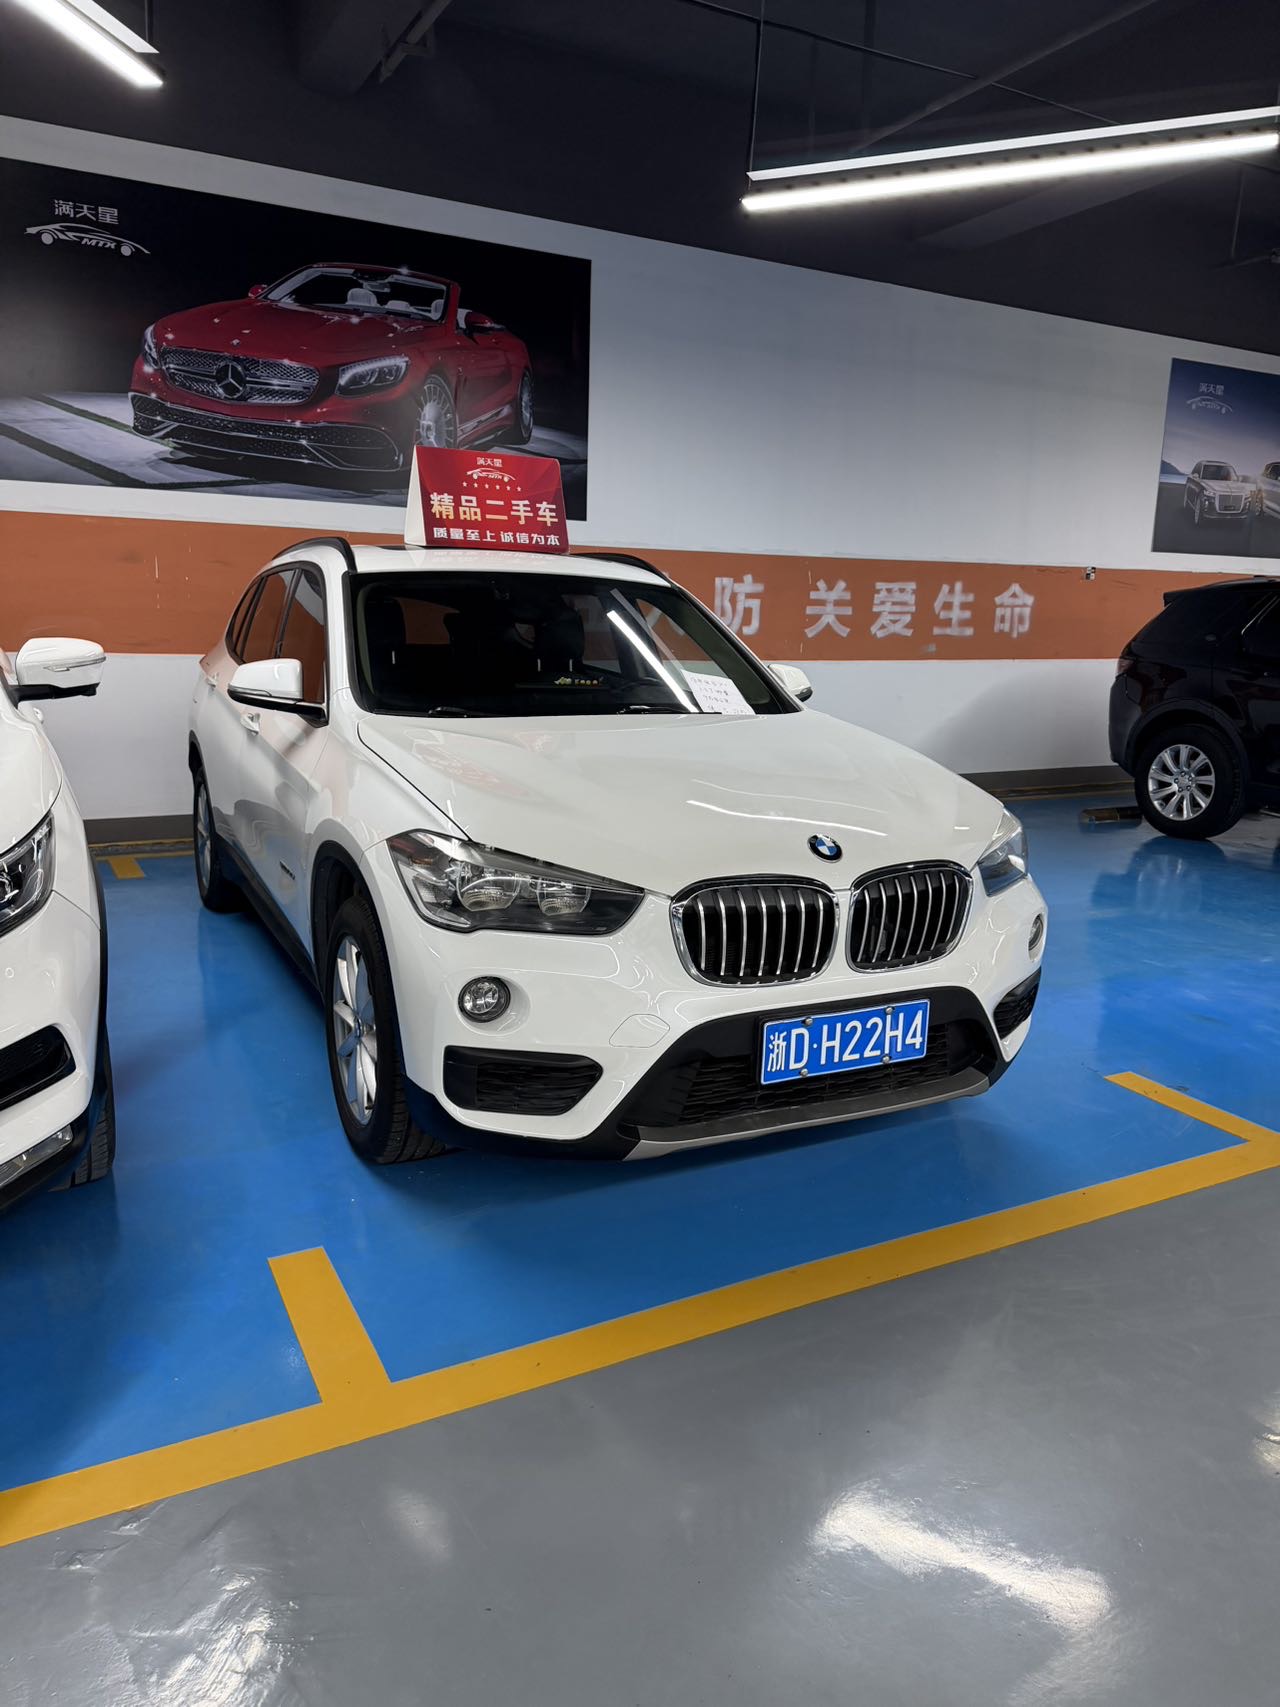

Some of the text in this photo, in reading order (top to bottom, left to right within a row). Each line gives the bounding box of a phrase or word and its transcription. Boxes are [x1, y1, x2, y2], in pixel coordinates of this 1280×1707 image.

[54, 199, 119, 225] 满天星
[81, 238, 117, 249] MTX
[430, 492, 559, 527] 精品二手车
[433, 527, 560, 546] 质量至上 诚信为本
[804, 578, 1036, 640] 关爱生命
[767, 1010, 923, 1072] 浙D·H22H4
